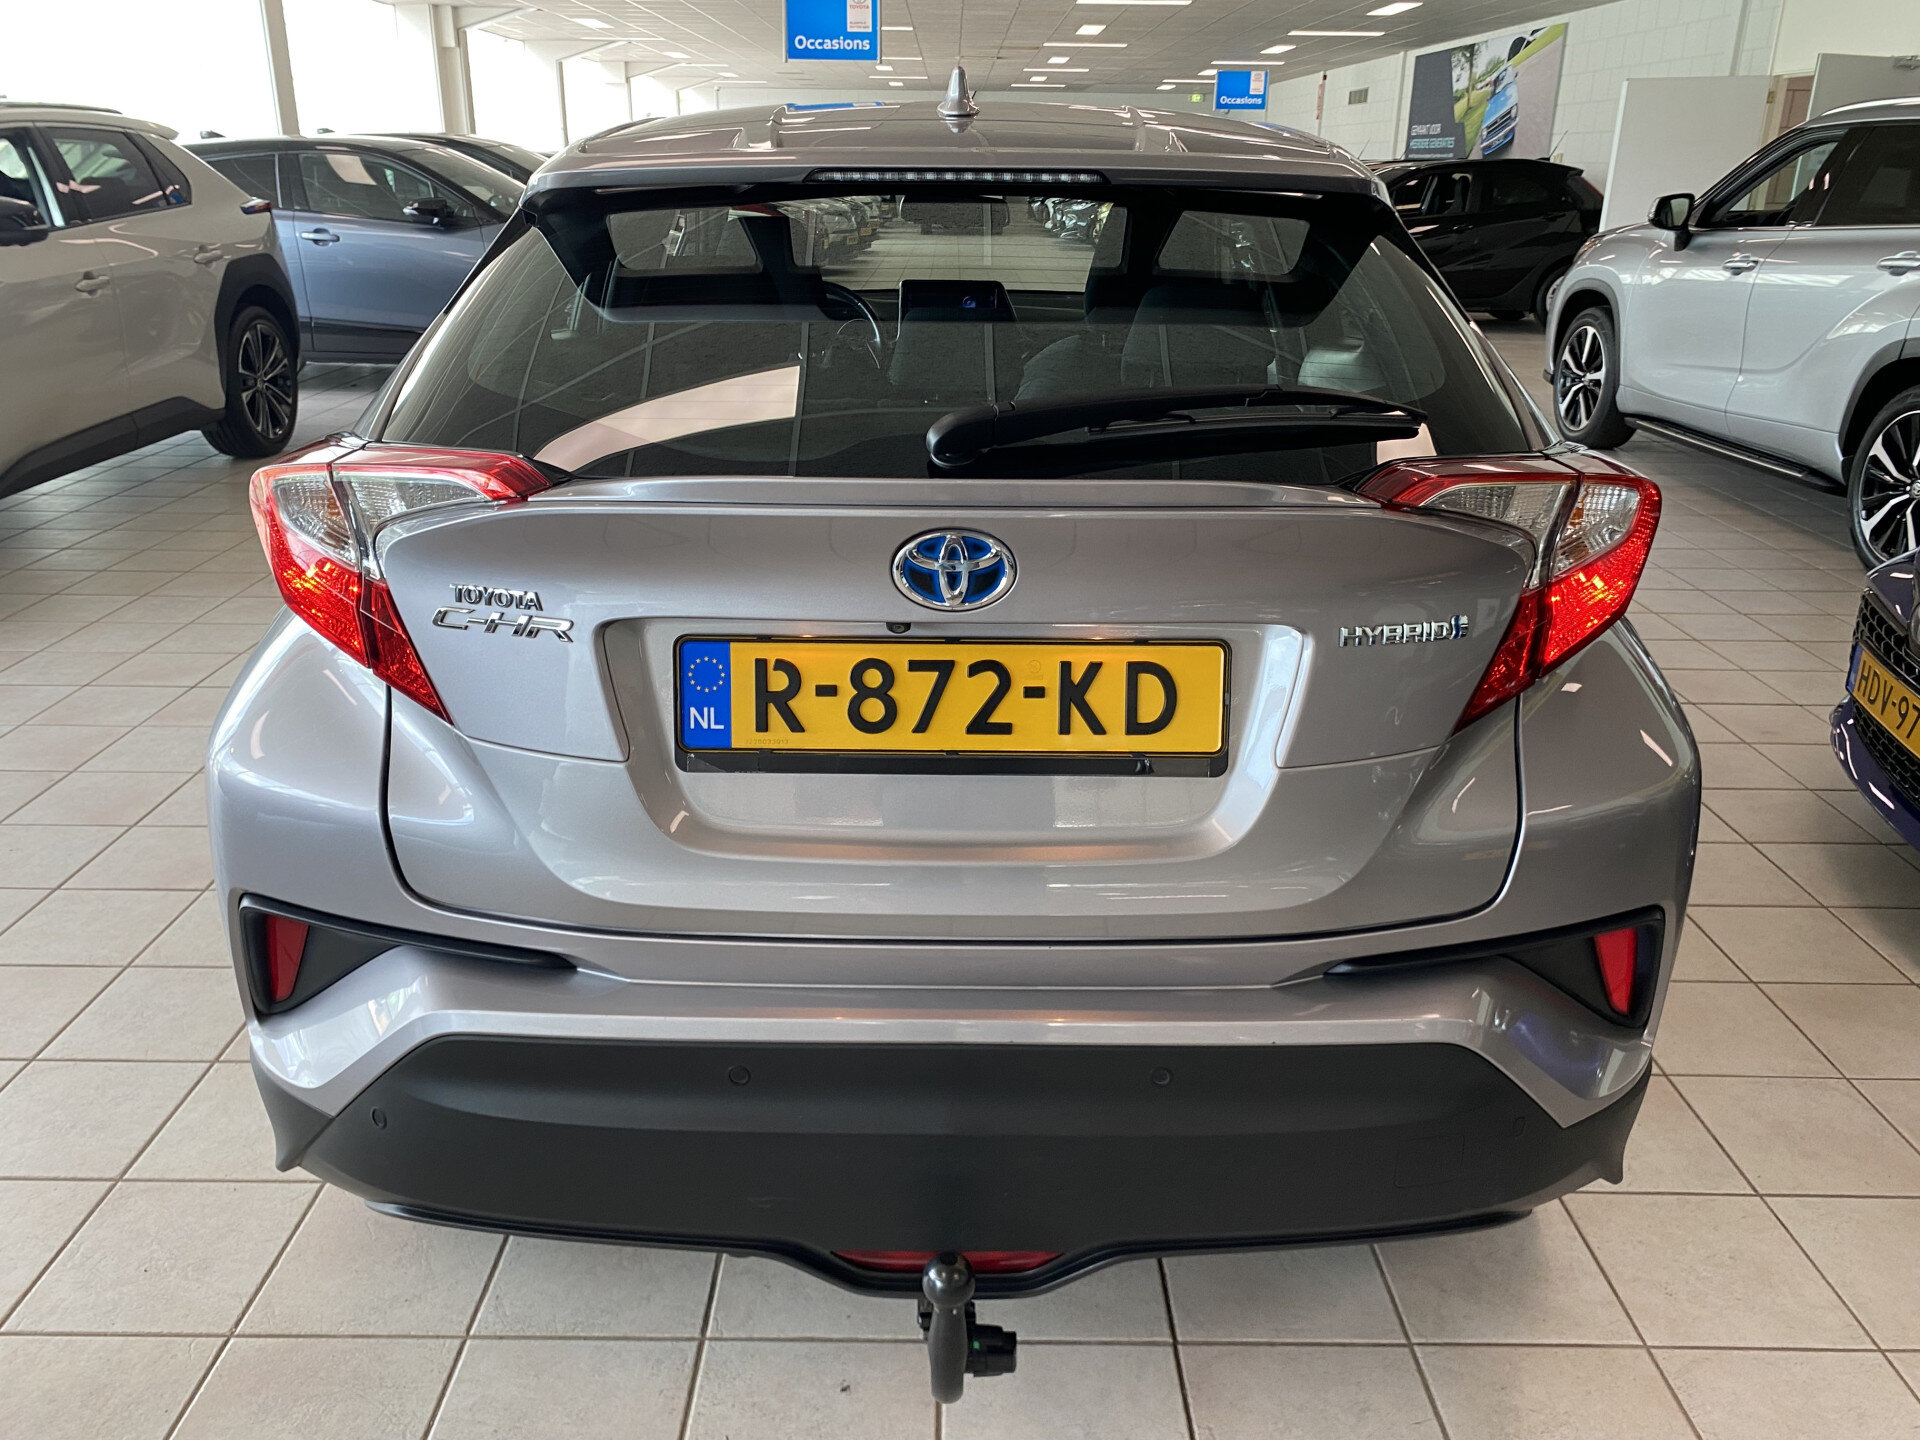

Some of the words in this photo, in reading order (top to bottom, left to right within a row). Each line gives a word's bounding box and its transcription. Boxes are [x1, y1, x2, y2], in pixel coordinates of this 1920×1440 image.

[794, 34, 871, 51] Occasions
[1220, 95, 1263, 105] Occasions
[449, 583, 544, 612] TOYOTA
[431, 605, 575, 643] C-HR
[1339, 620, 1451, 648] HYBRID
[754, 657, 1178, 736] R-872-KD
[689, 706, 725, 730] NL
